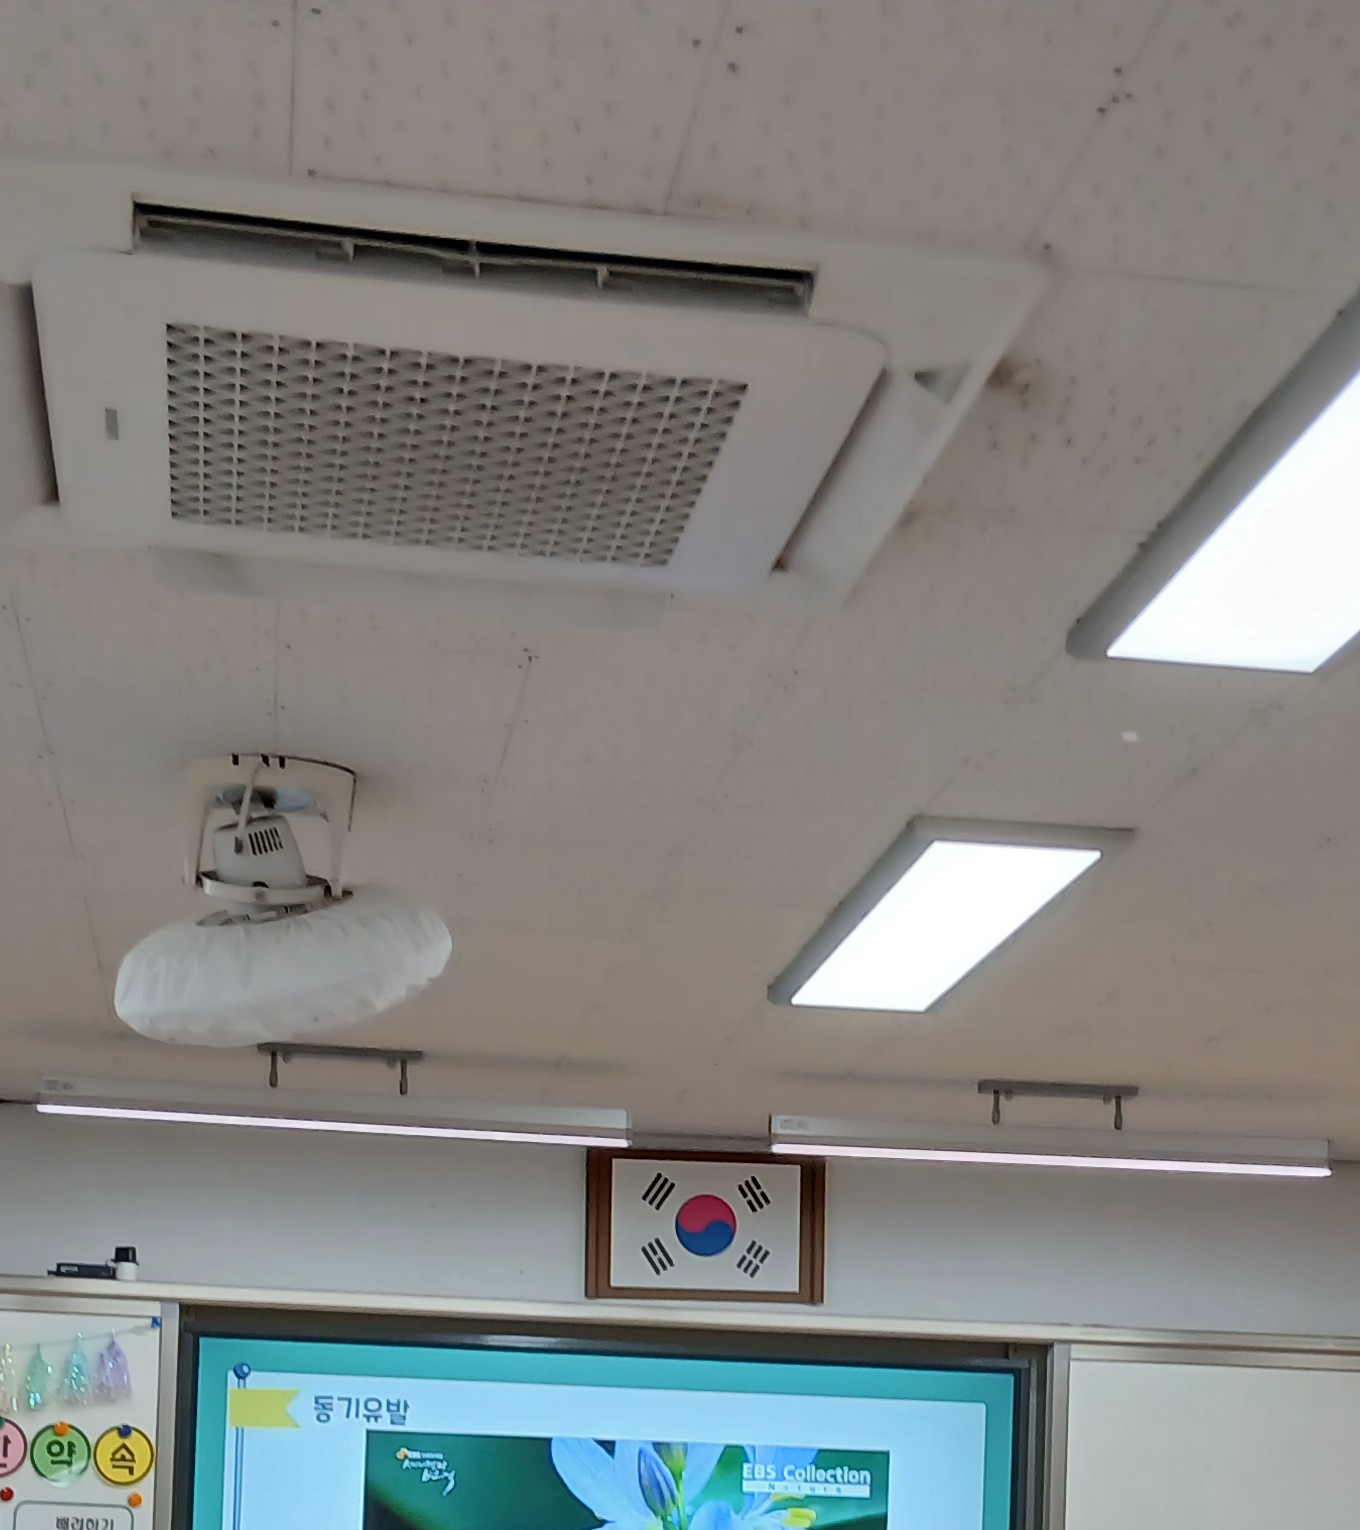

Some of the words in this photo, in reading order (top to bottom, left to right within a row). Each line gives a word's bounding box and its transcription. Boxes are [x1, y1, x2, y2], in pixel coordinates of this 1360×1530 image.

[312, 1395, 410, 1426] 동기유발
[742, 1462, 776, 1480] EBS
[783, 1464, 872, 1485] Collection
